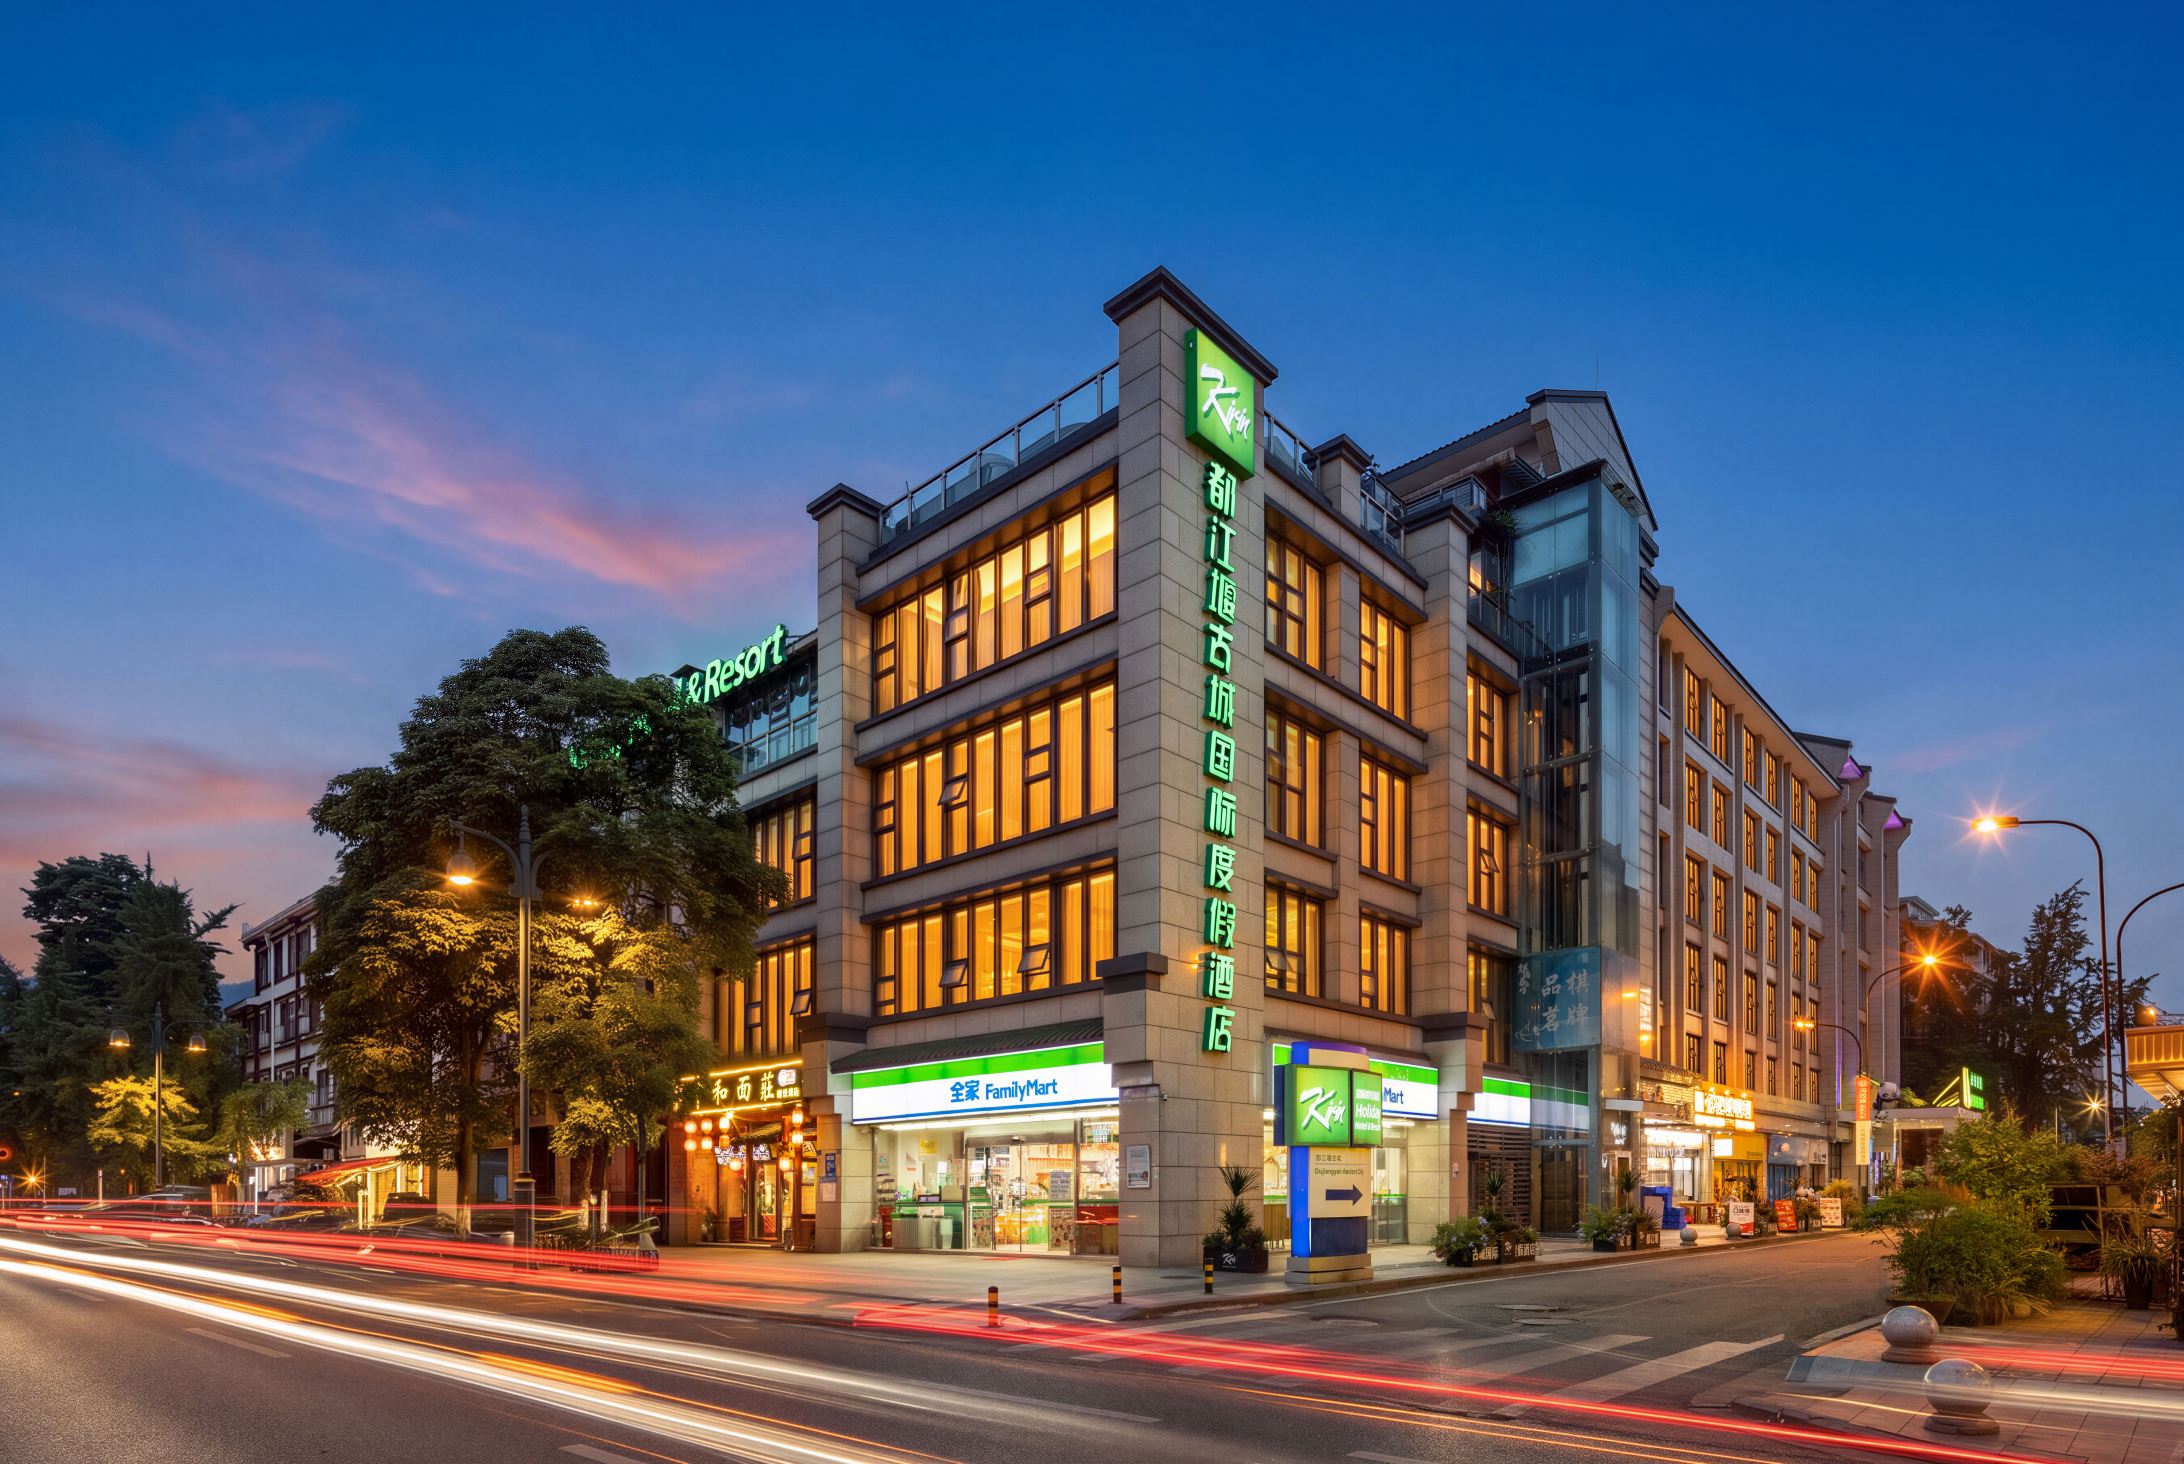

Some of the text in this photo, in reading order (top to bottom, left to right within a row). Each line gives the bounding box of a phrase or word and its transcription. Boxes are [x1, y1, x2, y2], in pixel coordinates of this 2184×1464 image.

[1200, 363, 1251, 439] Kirin
[704, 624, 786, 704] Resort
[1206, 461, 1236, 1052] 都江堰古城国际度假酒店
[950, 1080, 980, 1103] 全家
[985, 1079, 1058, 1102] FamilyMart
[1300, 1087, 1346, 1131] Kirin
[1355, 1103, 1380, 1124] Holiday
